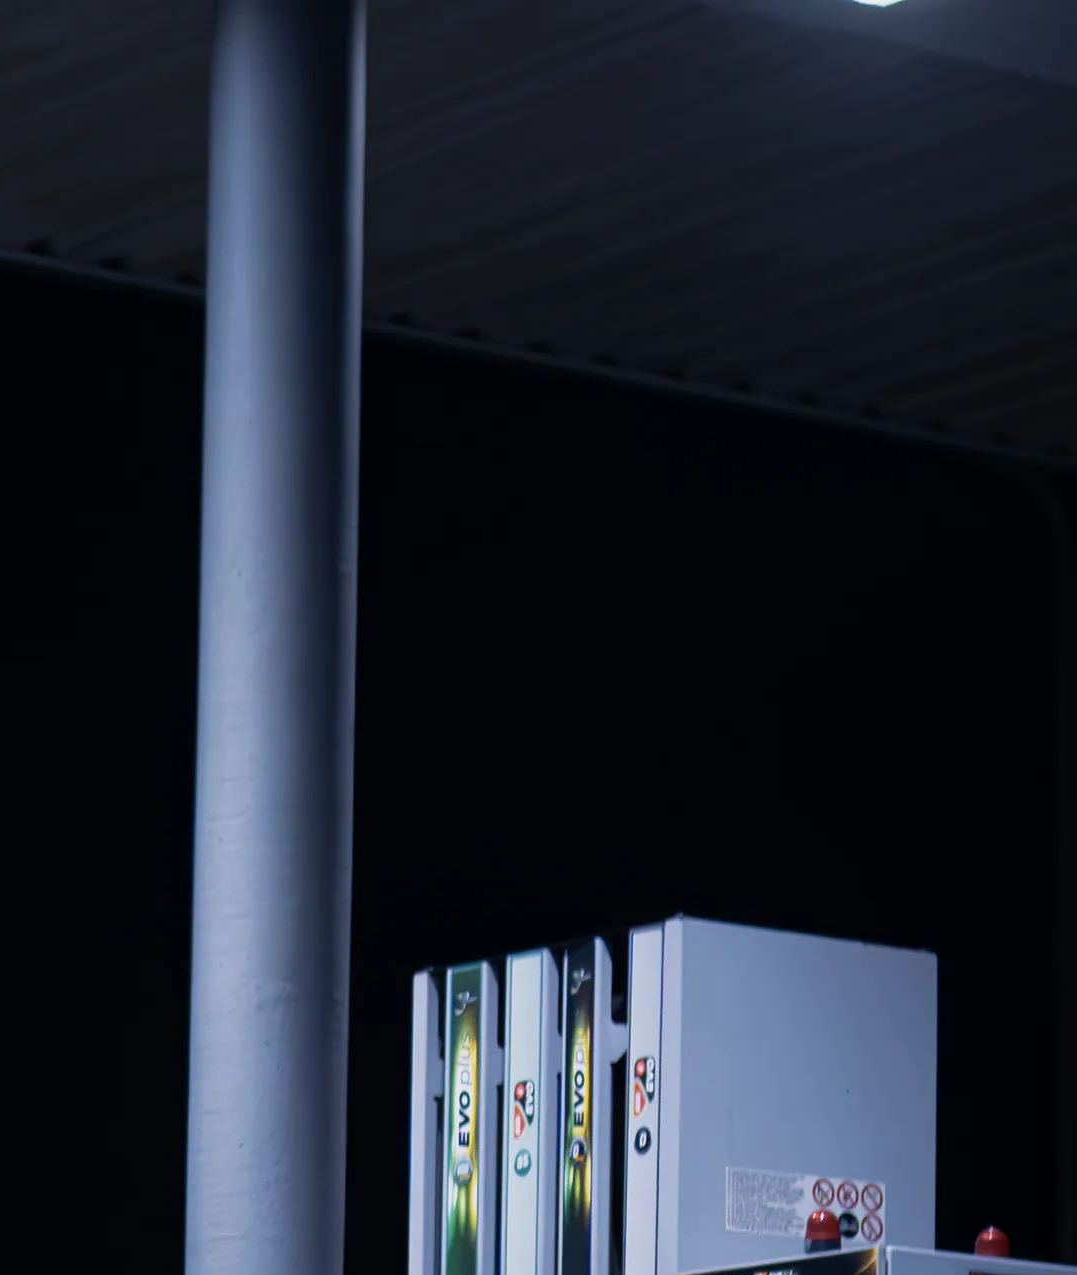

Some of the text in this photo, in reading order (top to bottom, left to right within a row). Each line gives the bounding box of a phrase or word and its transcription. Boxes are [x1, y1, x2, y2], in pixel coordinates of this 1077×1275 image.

[456, 1031, 473, 1086] plus
[457, 1090, 470, 1147] EVO
[574, 1070, 585, 1127] EVO
